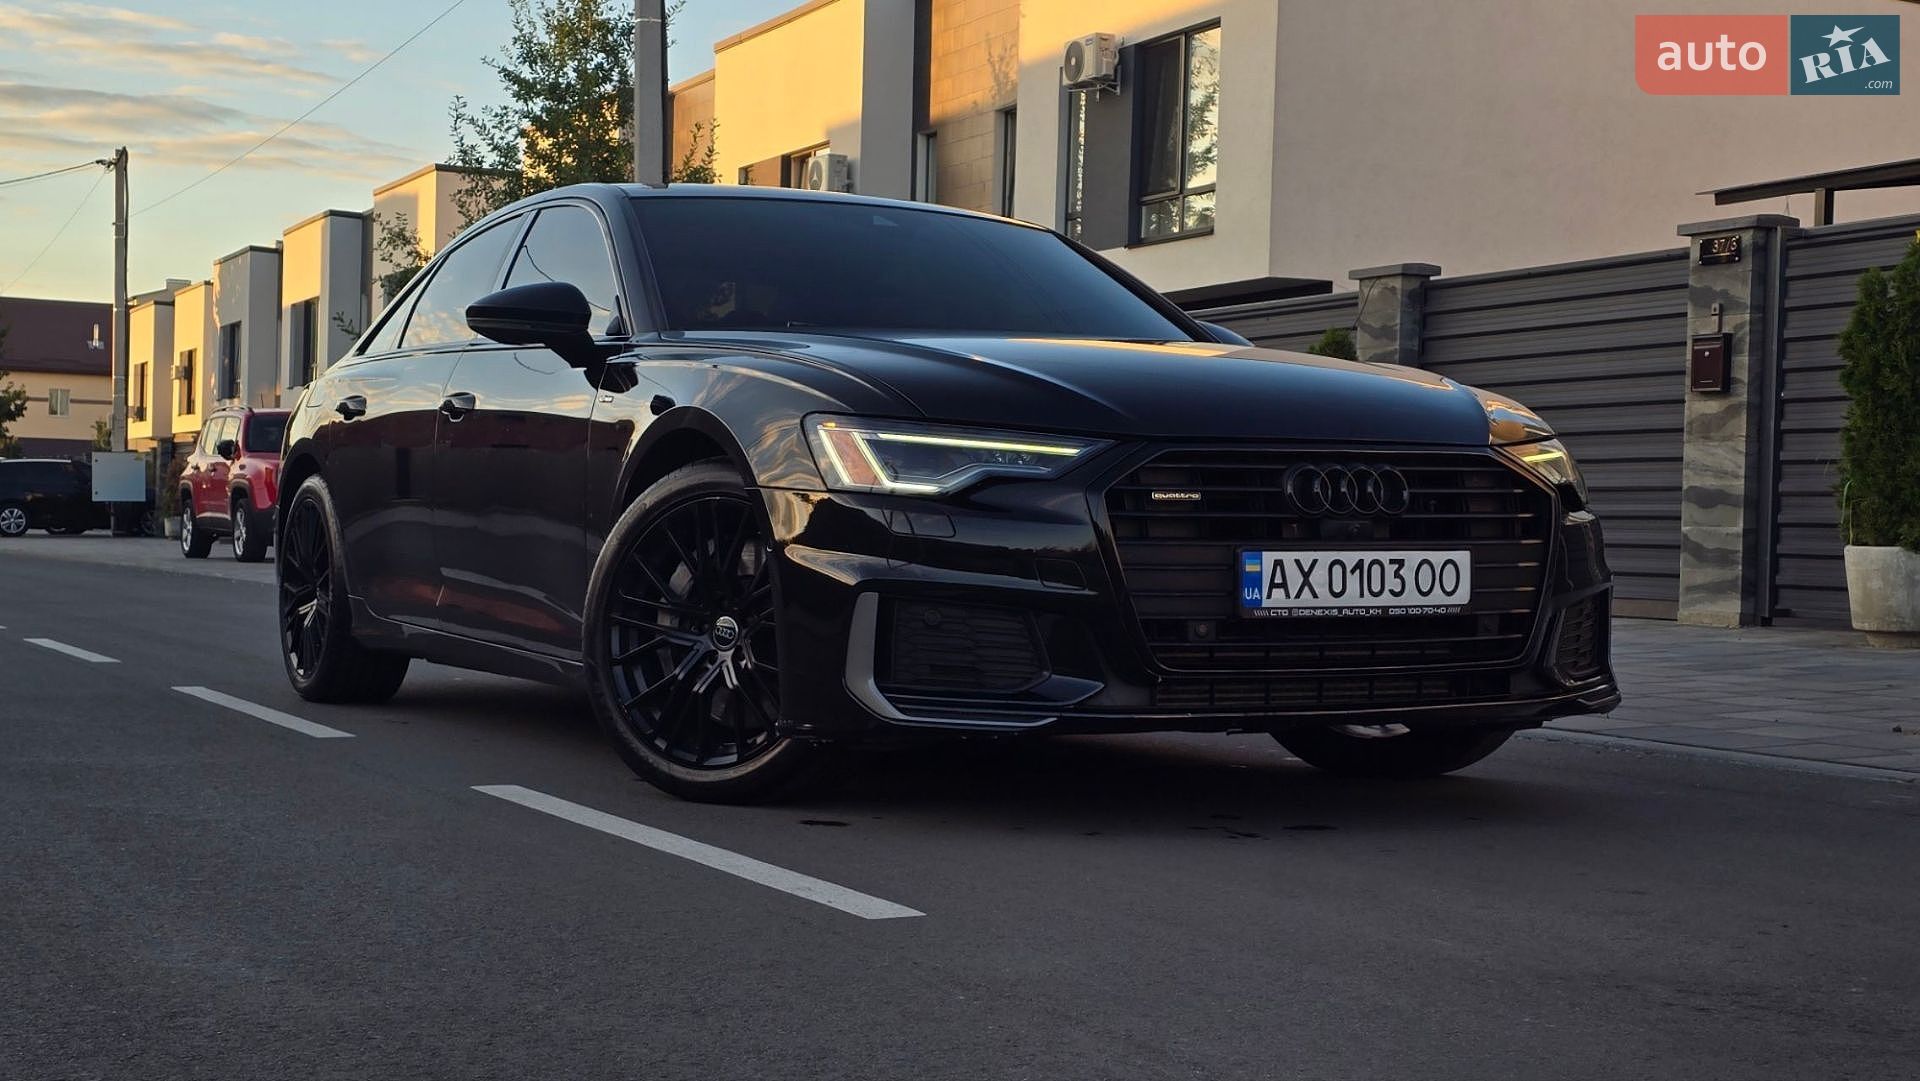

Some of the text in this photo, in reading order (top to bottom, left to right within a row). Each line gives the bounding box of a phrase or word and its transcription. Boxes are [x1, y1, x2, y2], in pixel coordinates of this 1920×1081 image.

[1153, 492, 1200, 500] quattro
[1266, 558, 1319, 600] AX
[1328, 558, 1406, 599] 0103
[1245, 588, 1261, 600] UA
